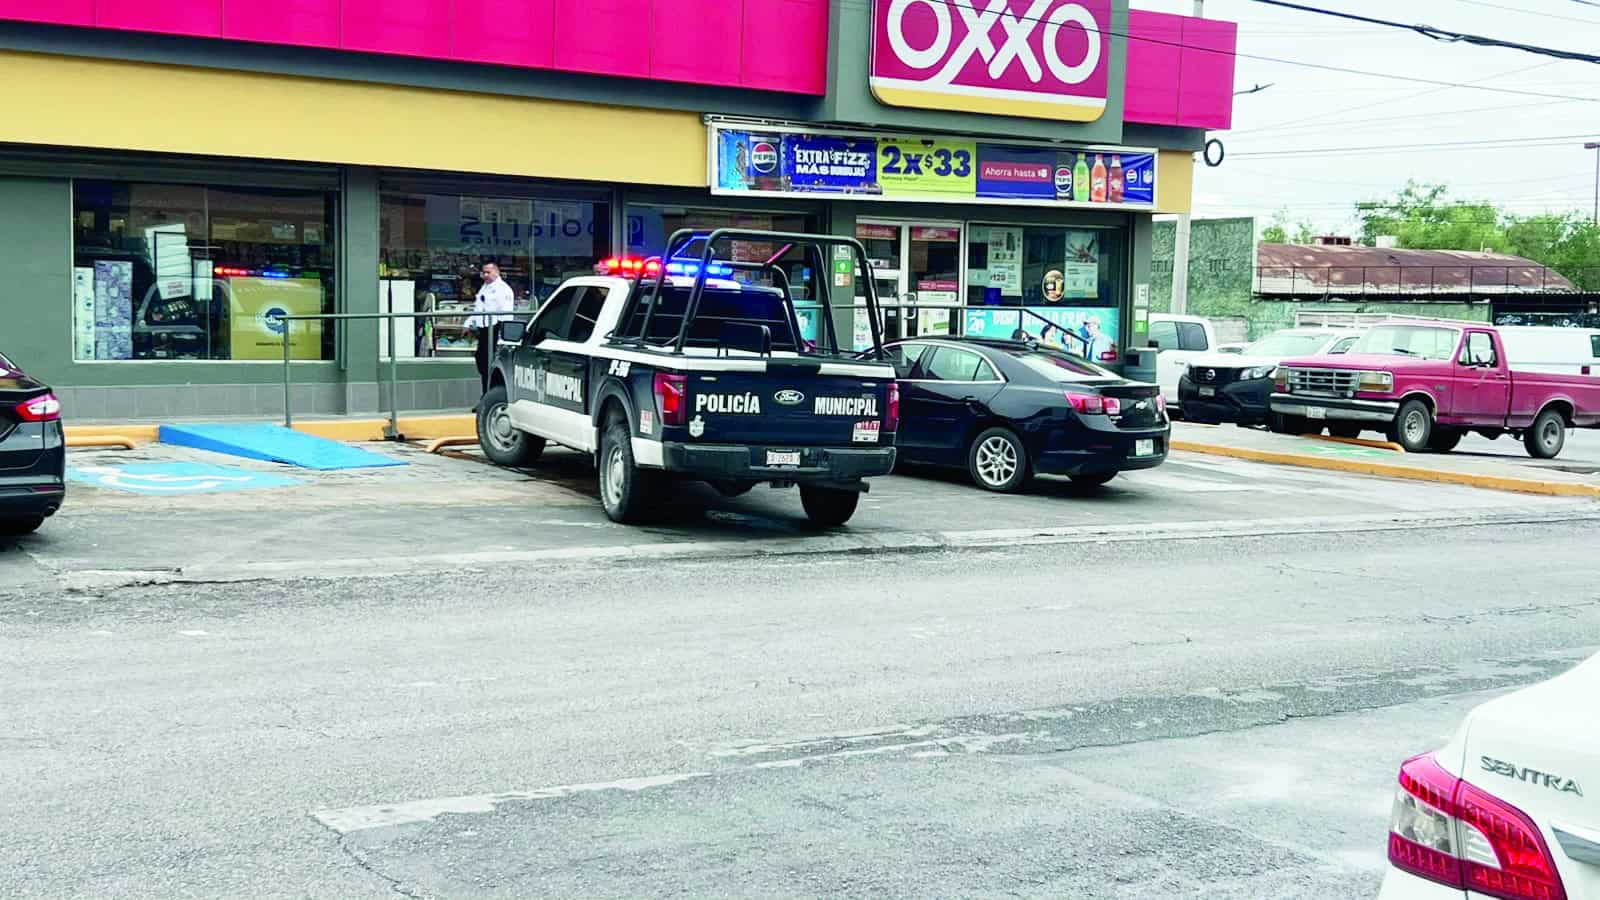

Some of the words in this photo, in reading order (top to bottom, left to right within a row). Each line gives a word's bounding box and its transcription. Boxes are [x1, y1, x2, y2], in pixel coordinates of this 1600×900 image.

[886, 0, 1101, 84] OXXO
[795, 149, 828, 164] EXTRA
[796, 163, 829, 176] MÁS
[984, 166, 1012, 178] Ahorra
[1014, 168, 1036, 178] hasta
[695, 392, 761, 414] POLICÍA
[779, 392, 801, 403] Ford
[814, 396, 878, 417] MUNICIPAL
[1481, 756, 1584, 797] SENTRA
